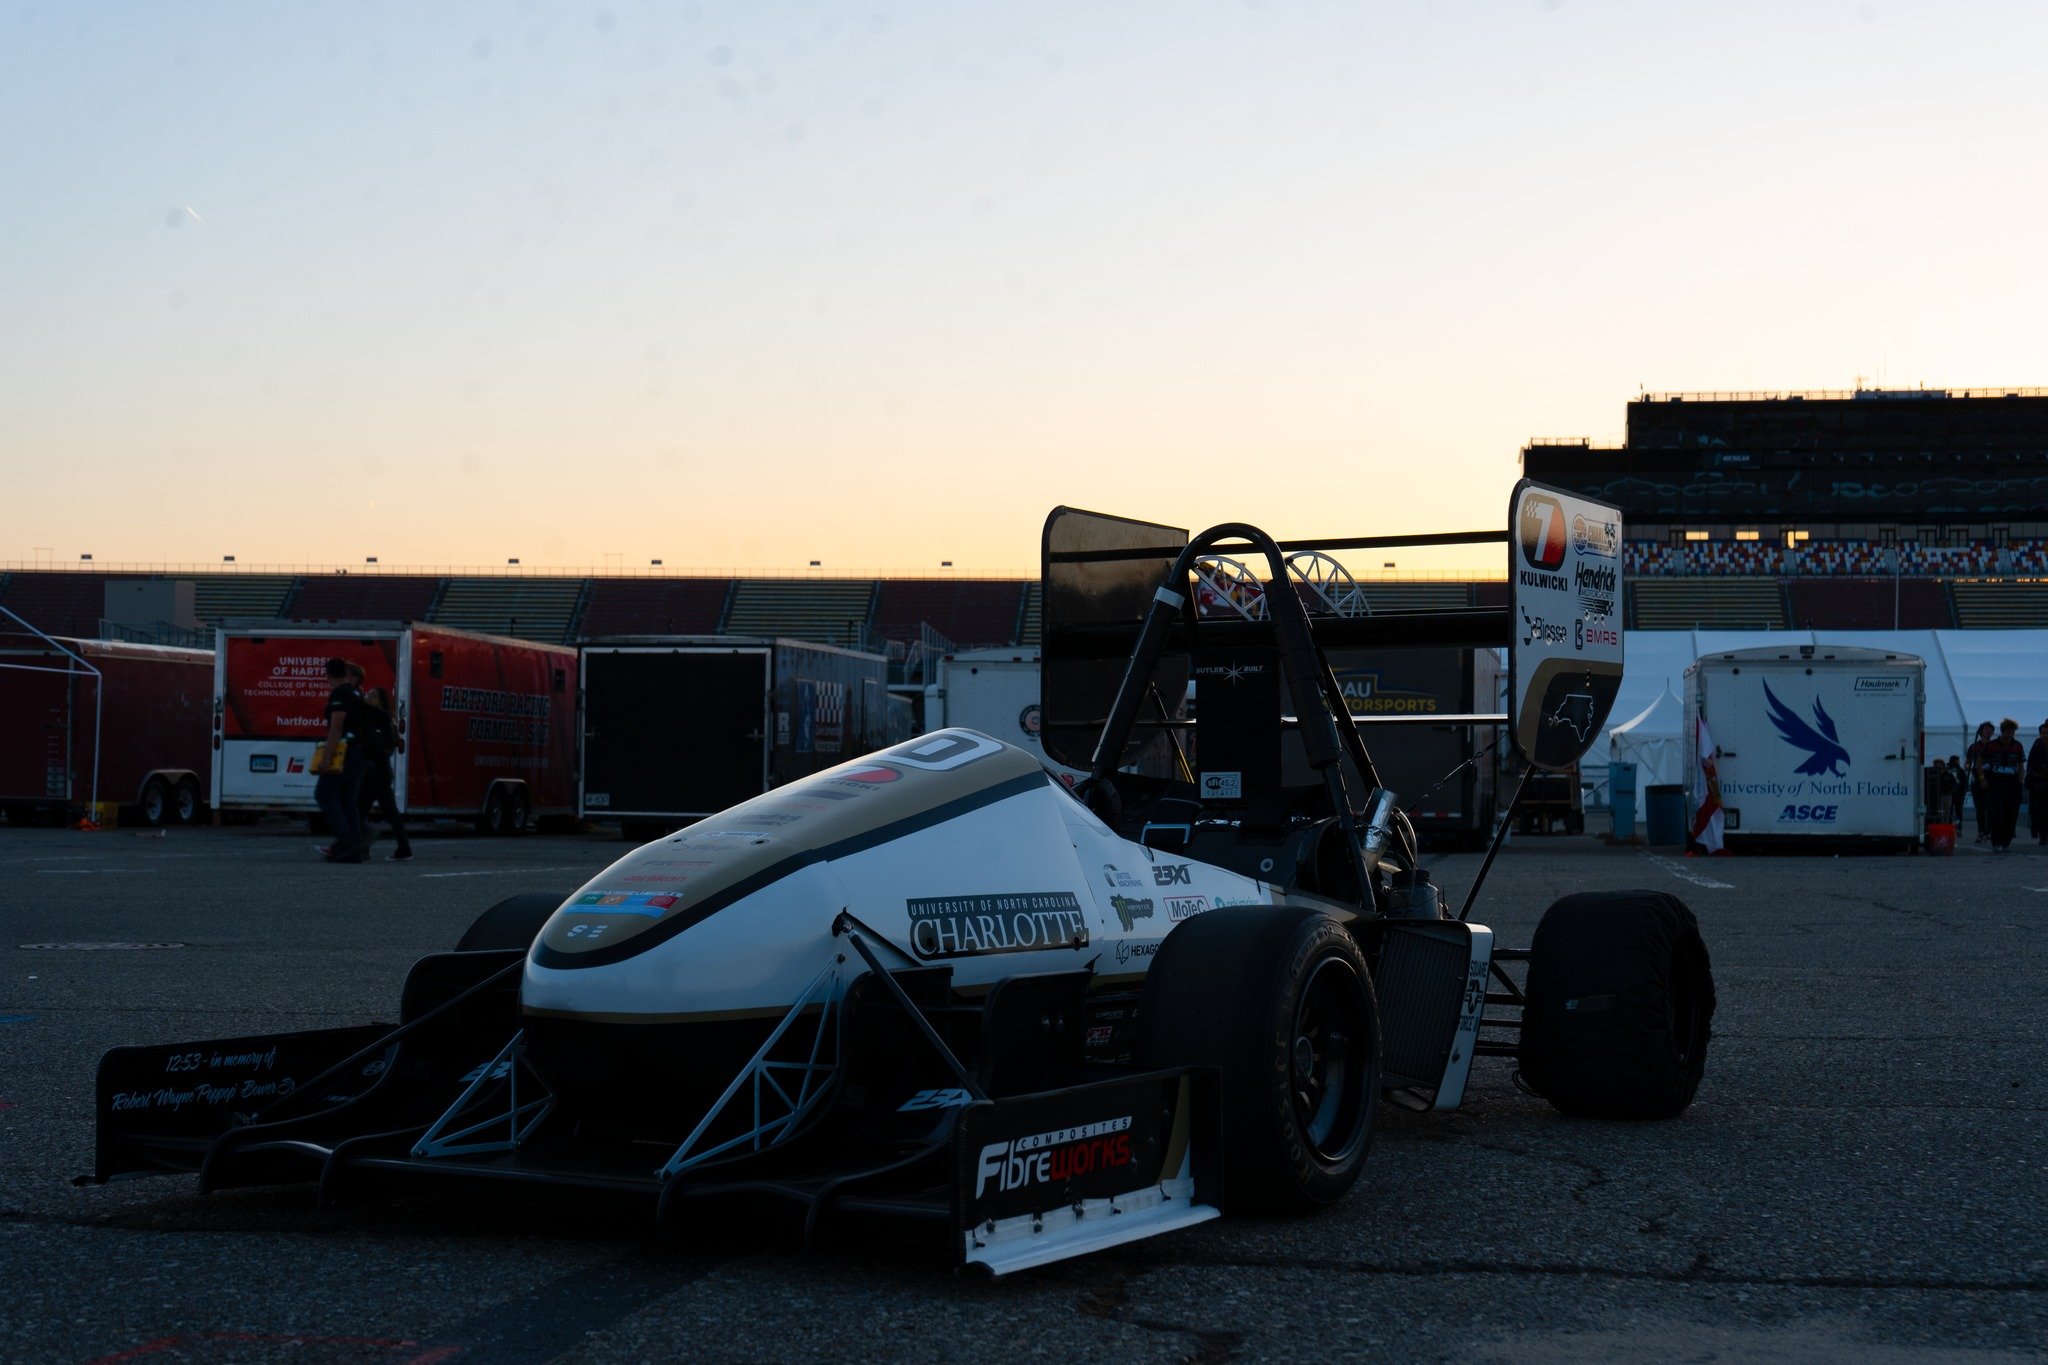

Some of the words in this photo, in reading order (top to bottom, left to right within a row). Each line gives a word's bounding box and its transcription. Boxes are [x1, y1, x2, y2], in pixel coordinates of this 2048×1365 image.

[1520, 570, 1568, 592] KULWICKI
[1575, 561, 1617, 595] Hendrick
[1581, 588, 1614, 599] MOTORSPORTS
[1587, 629, 1617, 645] BMRS
[273, 666, 288, 675] OF
[1196, 666, 1225, 674] BUTLER
[258, 681, 293, 689] COLLEGE
[1339, 681, 1371, 698] AU
[1861, 679, 1900, 688] Haulmark
[244, 689, 298, 697] TECHNOLOGY,
[441, 685, 508, 714] HARTFORD
[507, 691, 552, 718] RACING
[466, 717, 525, 744] FORMULA
[474, 755, 509, 767] UNIVERSITY
[1787, 780, 1804, 797] of
[1811, 781, 1851, 795] North
[1857, 781, 1908, 796] Florida
[1779, 805, 1838, 820] ASCE
[1115, 872, 1132, 880] UNITED
[1118, 879, 1144, 887] MACHINING
[910, 901, 977, 917] UNIVERSITY
[981, 900, 992, 912] OF
[997, 898, 1028, 911] NORTH
[1032, 896, 1077, 909] CAROLINA
[1171, 899, 1205, 919] MoTeC
[913, 910, 1085, 955] CHARLOTTE
[166, 1053, 201, 1072] 12:53
[211, 1051, 222, 1068] in
[223, 1051, 262, 1072] memory
[263, 1046, 278, 1070] of
[112, 1091, 151, 1112] Robert
[154, 1087, 195, 1112] Wayne
[241, 1078, 277, 1099] Bower
[1021, 1118, 1128, 1150] COMPOSITES
